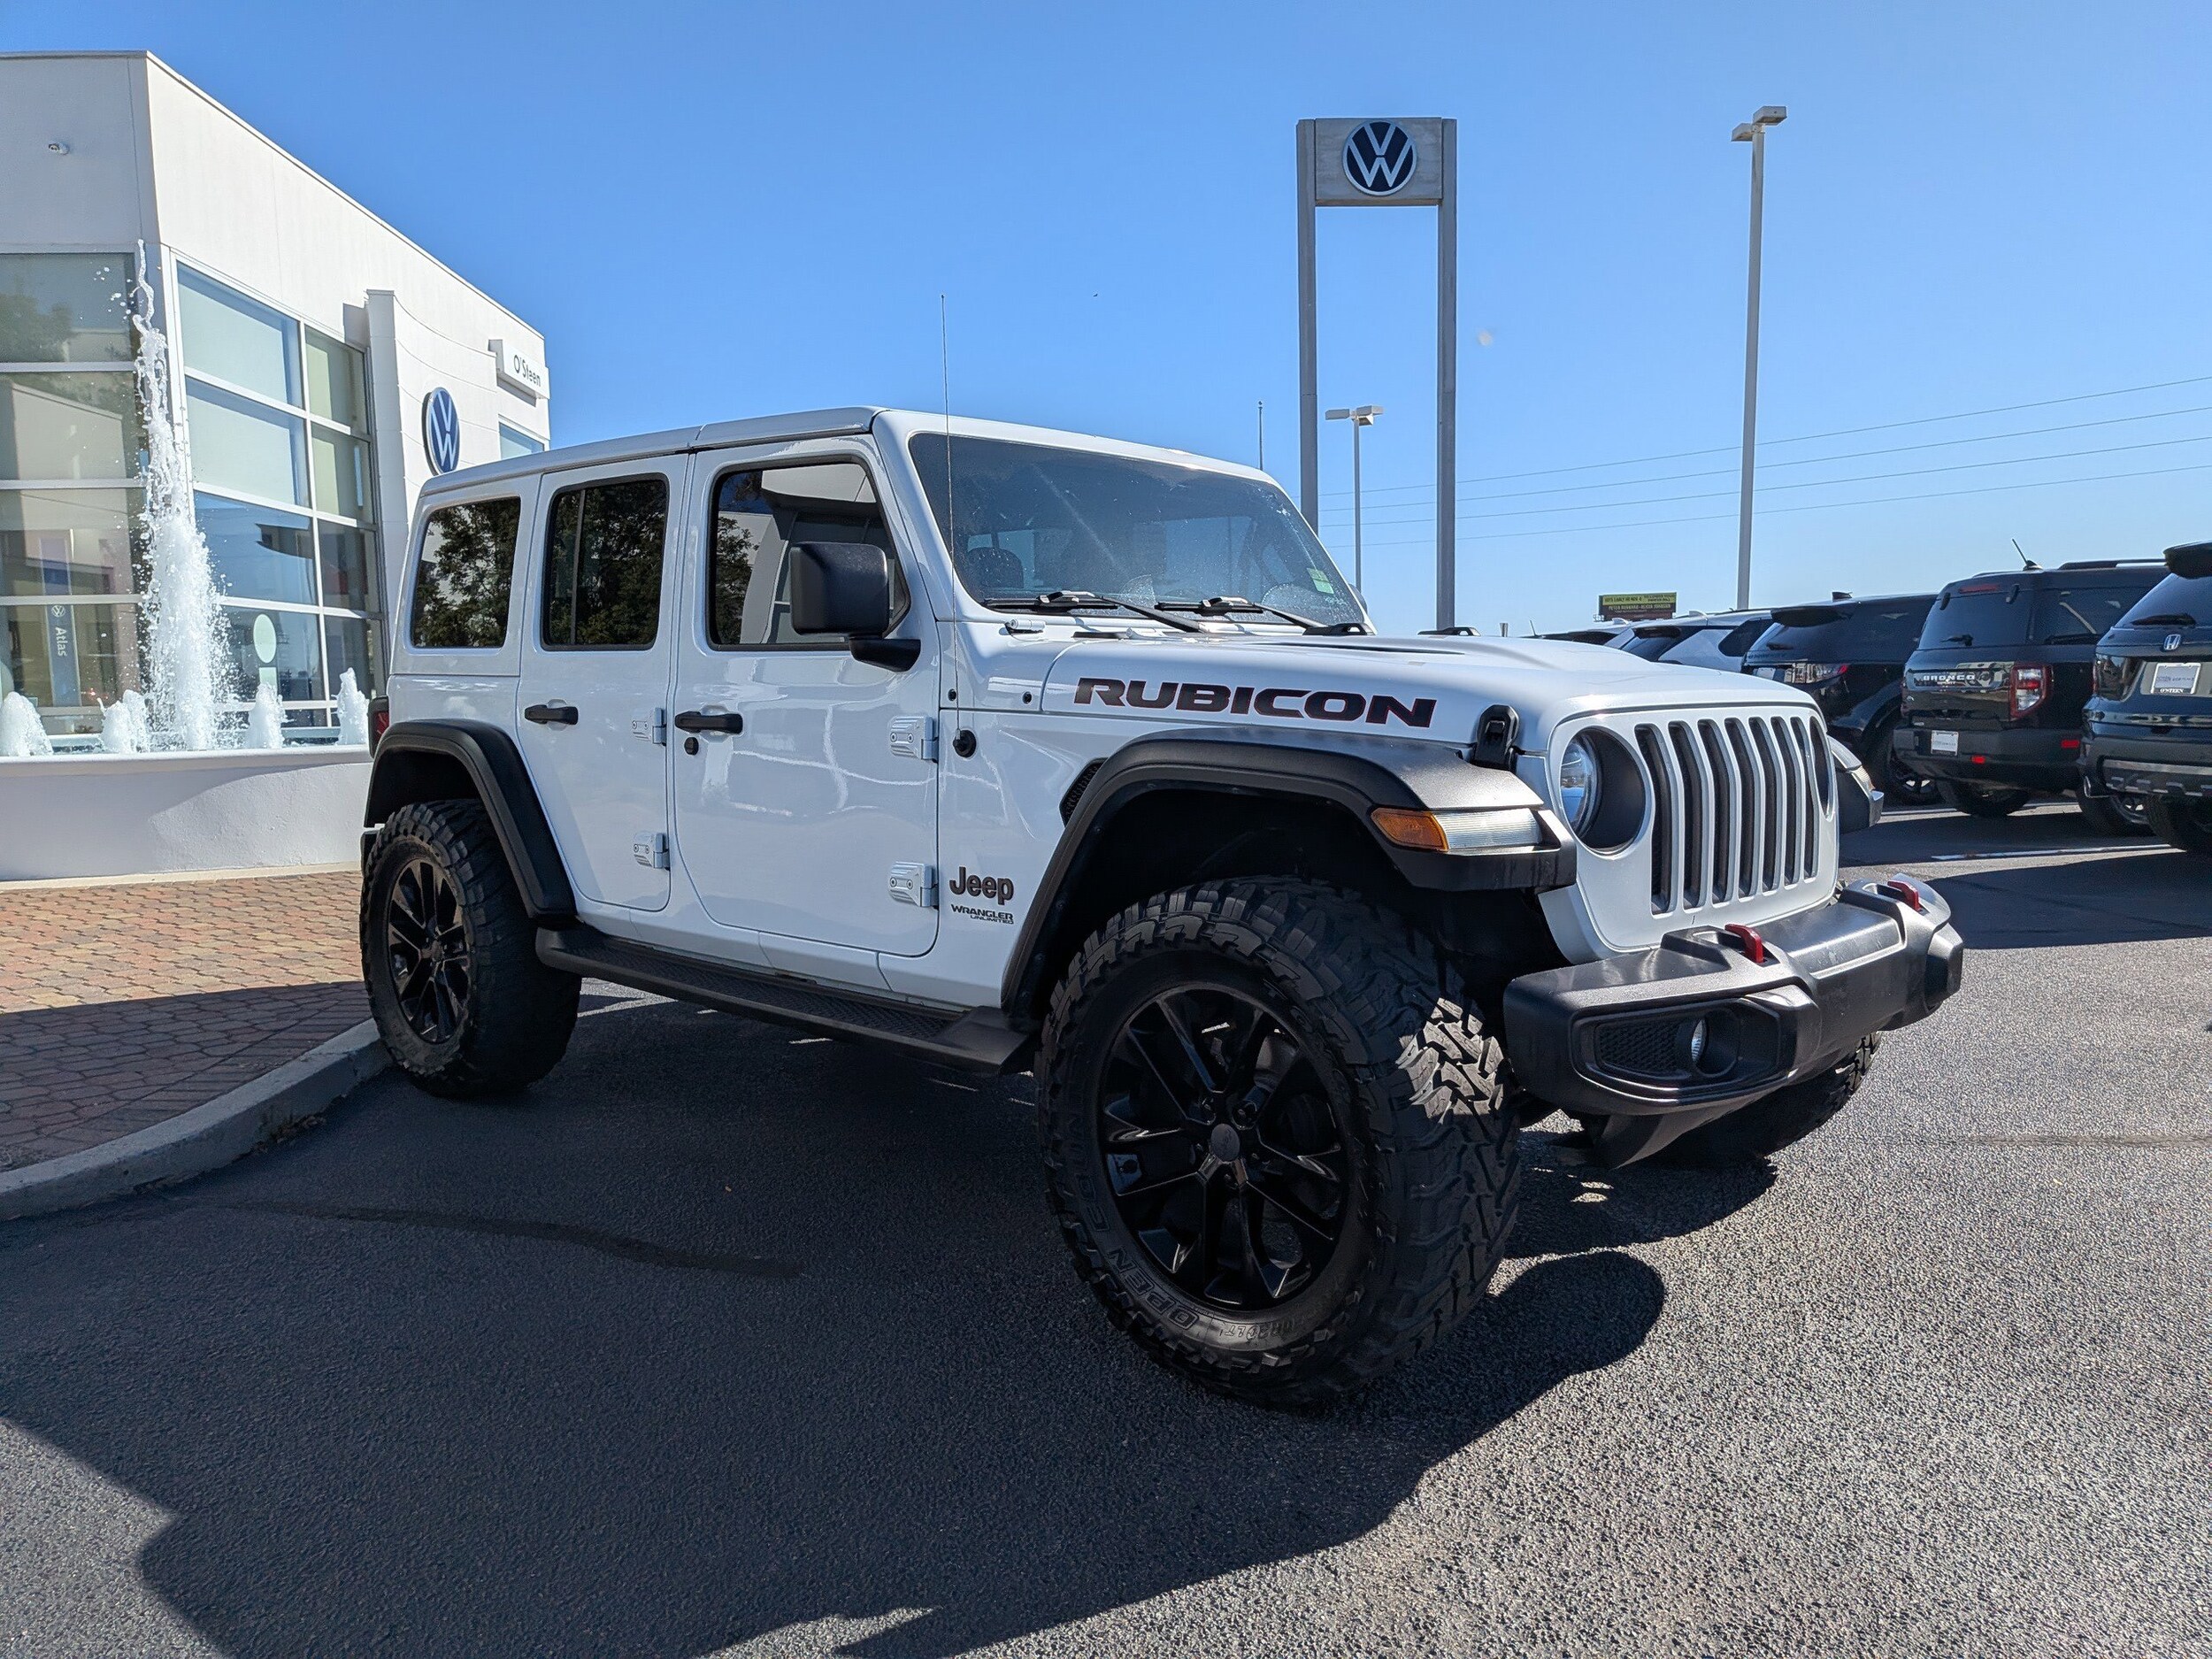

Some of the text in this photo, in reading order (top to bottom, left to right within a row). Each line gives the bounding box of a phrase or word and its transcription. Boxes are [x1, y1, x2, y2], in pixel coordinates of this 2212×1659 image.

[513, 354, 541, 388] O'Steen
[55, 626, 68, 657] Atlas
[1073, 677, 1438, 728] RUBICON
[949, 865, 1015, 906] Jeep
[950, 903, 1014, 921] WRANGLER
[970, 914, 1015, 925] UNLIMITED
[1106, 1246, 1200, 1330] OPEN
